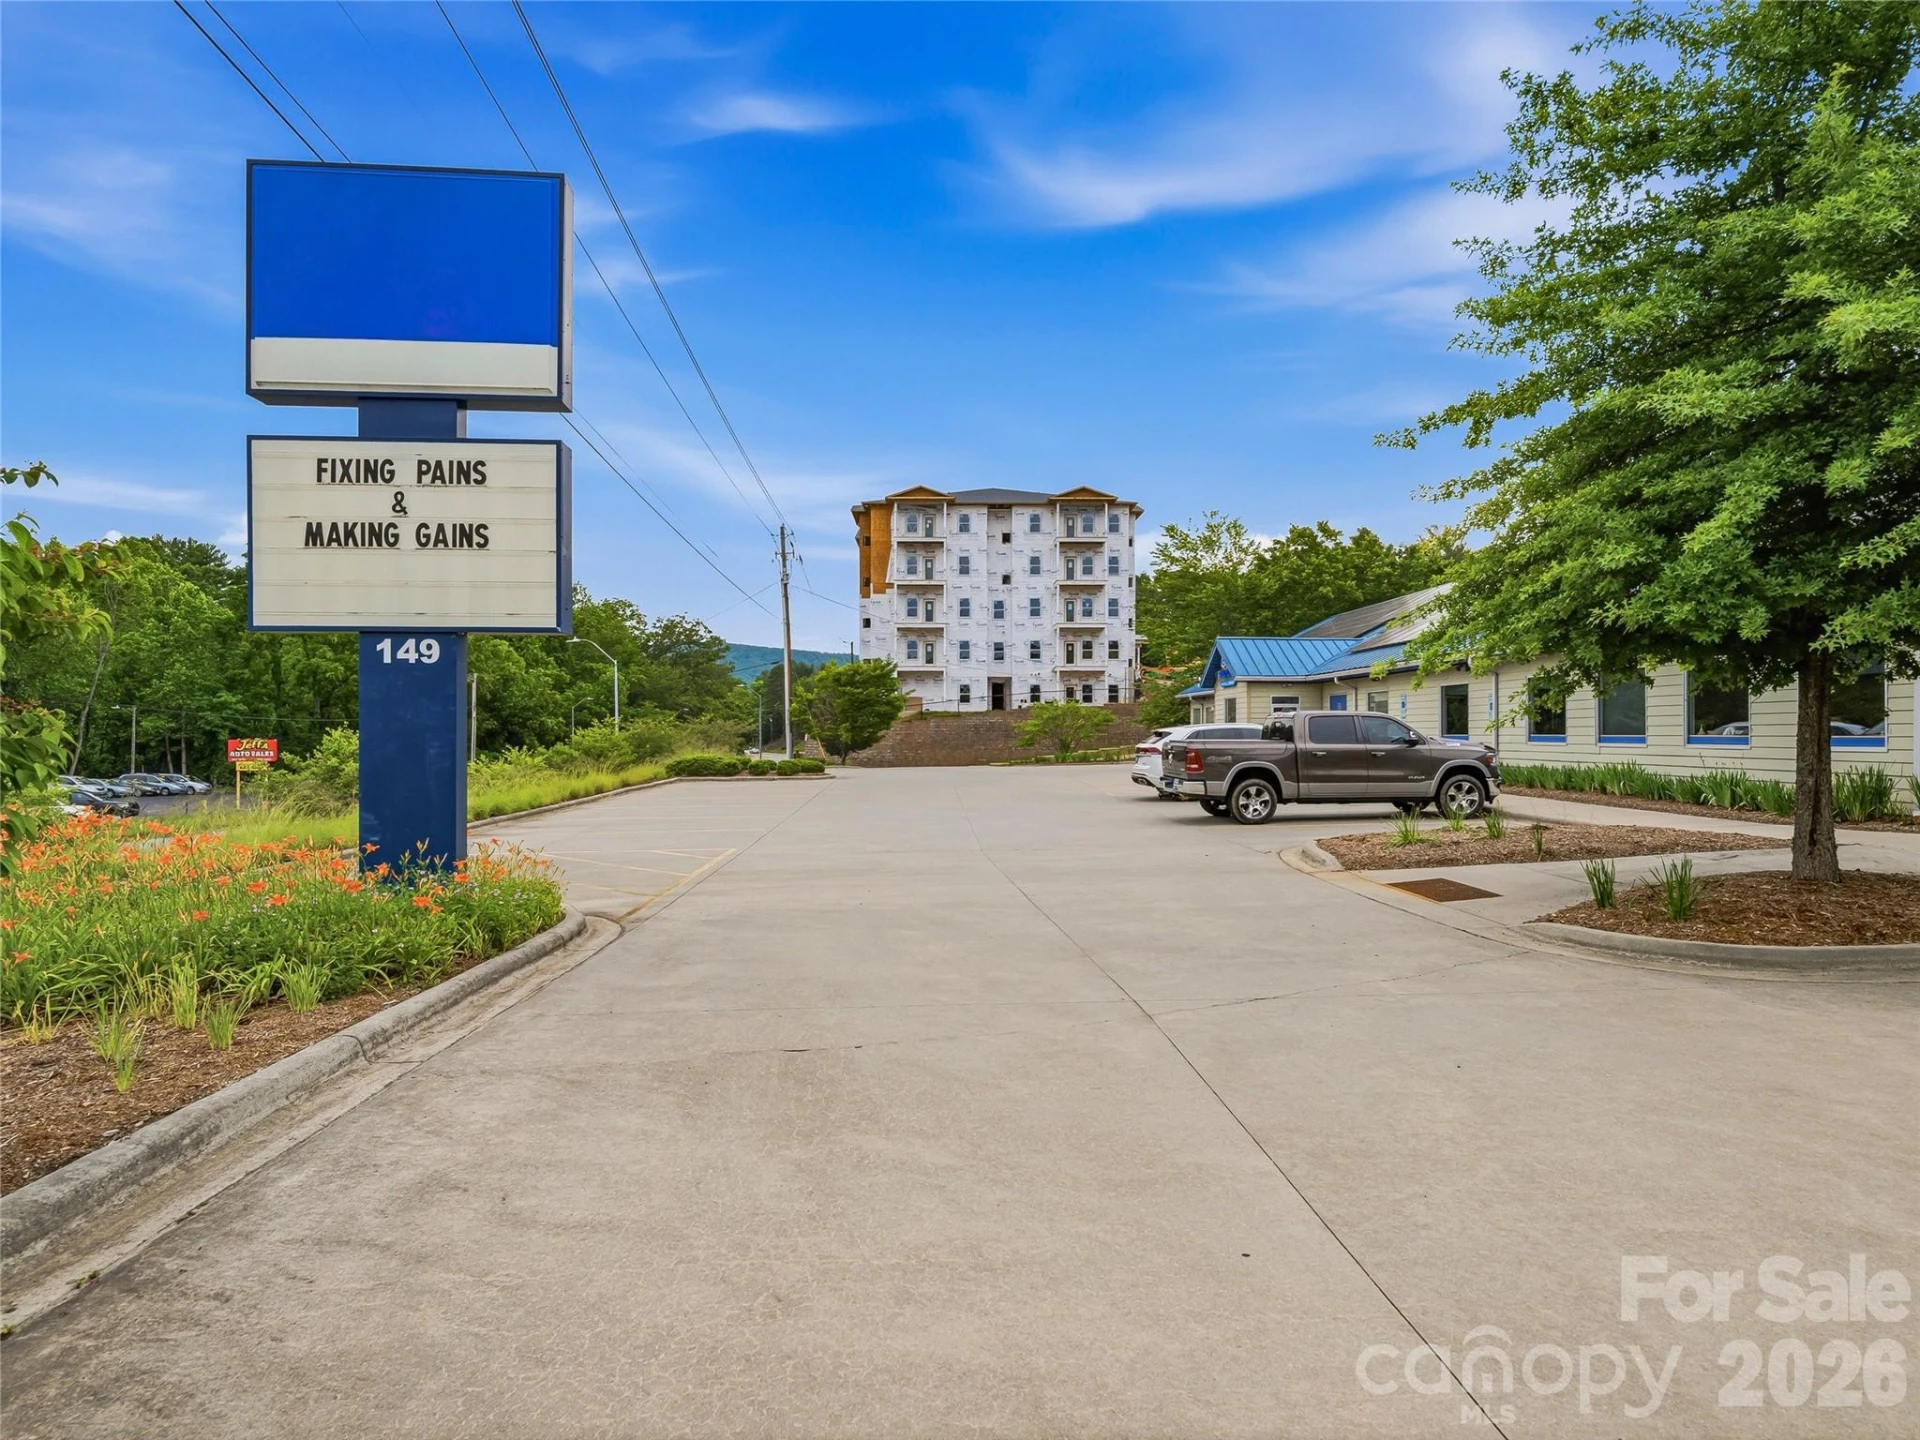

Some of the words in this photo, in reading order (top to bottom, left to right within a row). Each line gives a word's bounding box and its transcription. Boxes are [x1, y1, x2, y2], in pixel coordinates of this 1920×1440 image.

[316, 457, 396, 485] FIXING
[416, 459, 488, 486] PAINS
[391, 490, 409, 516] &
[304, 521, 400, 548] MAKING
[415, 522, 490, 549] GAINS
[375, 637, 441, 664] 149
